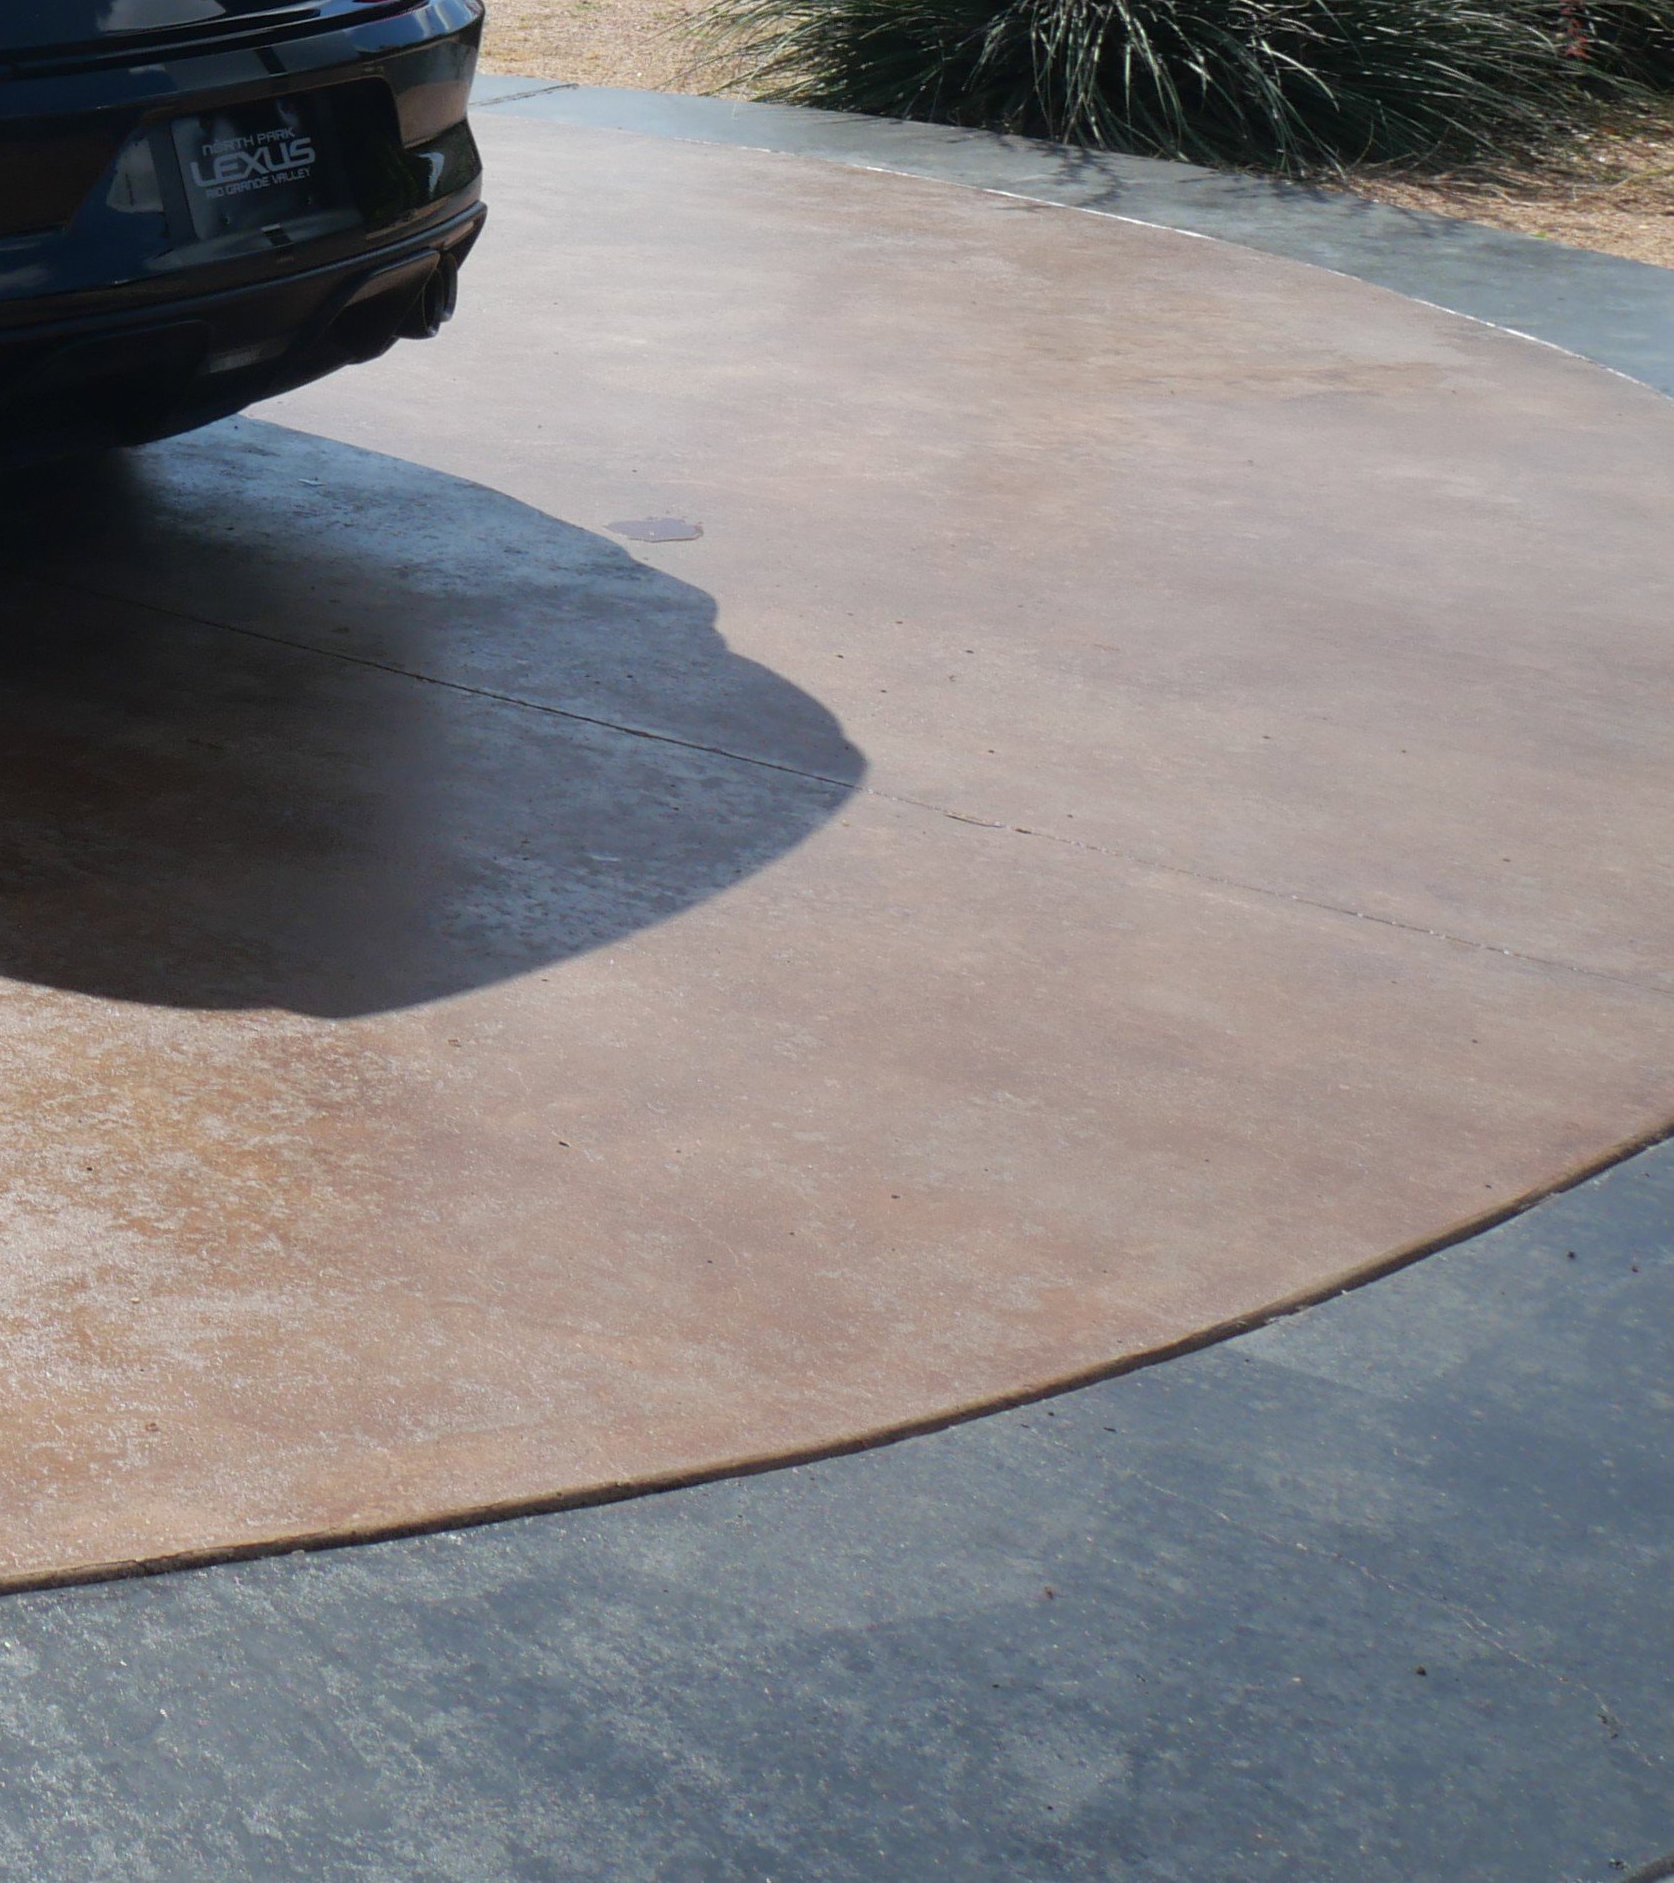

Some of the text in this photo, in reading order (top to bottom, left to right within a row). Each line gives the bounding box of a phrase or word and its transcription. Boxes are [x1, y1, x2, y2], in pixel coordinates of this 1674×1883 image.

[202, 126, 296, 156] NORTH PARK
[189, 137, 316, 187] LEXUS
[205, 167, 312, 199] RIO GRANDE VALLEY
